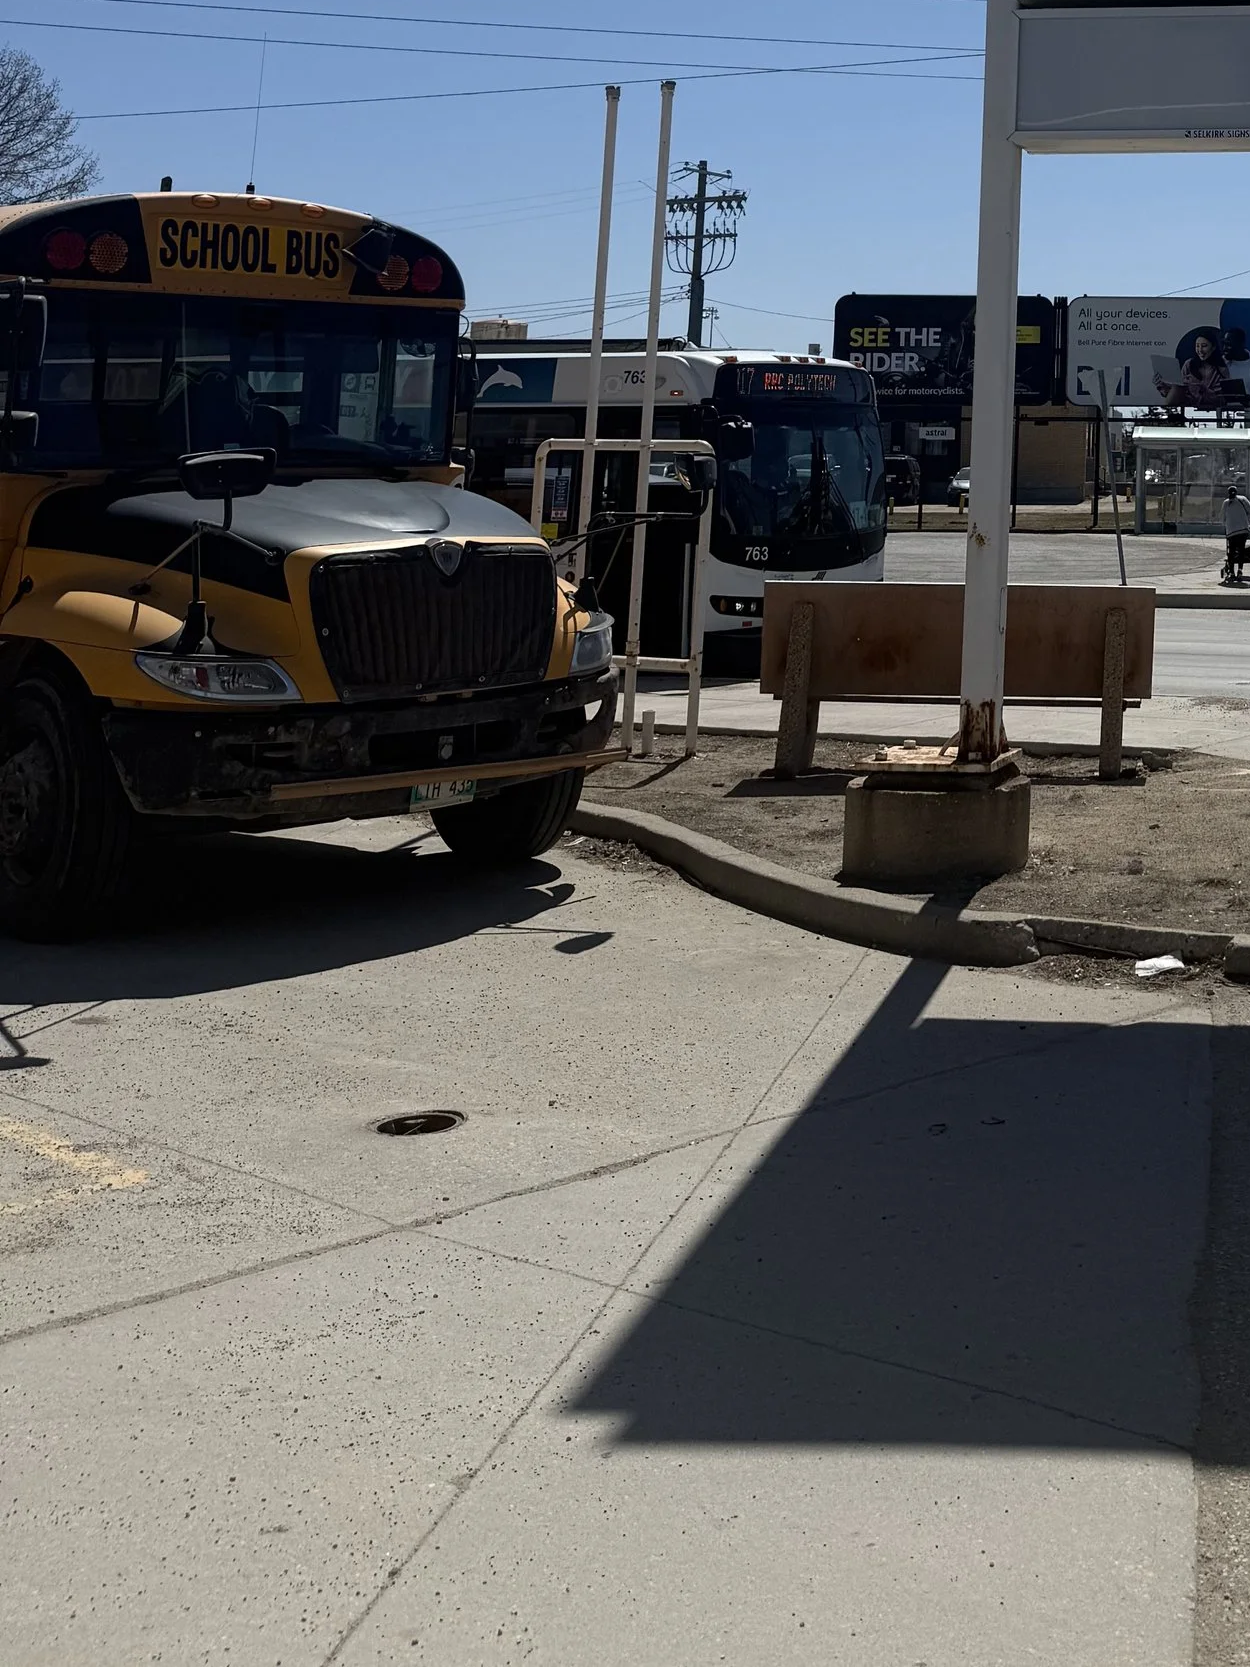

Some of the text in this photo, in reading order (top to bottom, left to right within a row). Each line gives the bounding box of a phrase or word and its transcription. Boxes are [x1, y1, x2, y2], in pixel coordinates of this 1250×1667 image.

[1193, 129, 1250, 139] SELKIRK SIGNS
[159, 218, 340, 279] SCHOOL BUS
[1078, 308, 1171, 321] All your devices.
[1078, 321, 1141, 331] All at once.
[849, 327, 942, 347] SEE THE
[849, 352, 926, 372] RIDER.
[787, 373, 837, 391] POLYTECH
[894, 386, 907, 395] for
[908, 386, 965, 397] motorcyclists.
[745, 546, 769, 561] 763
